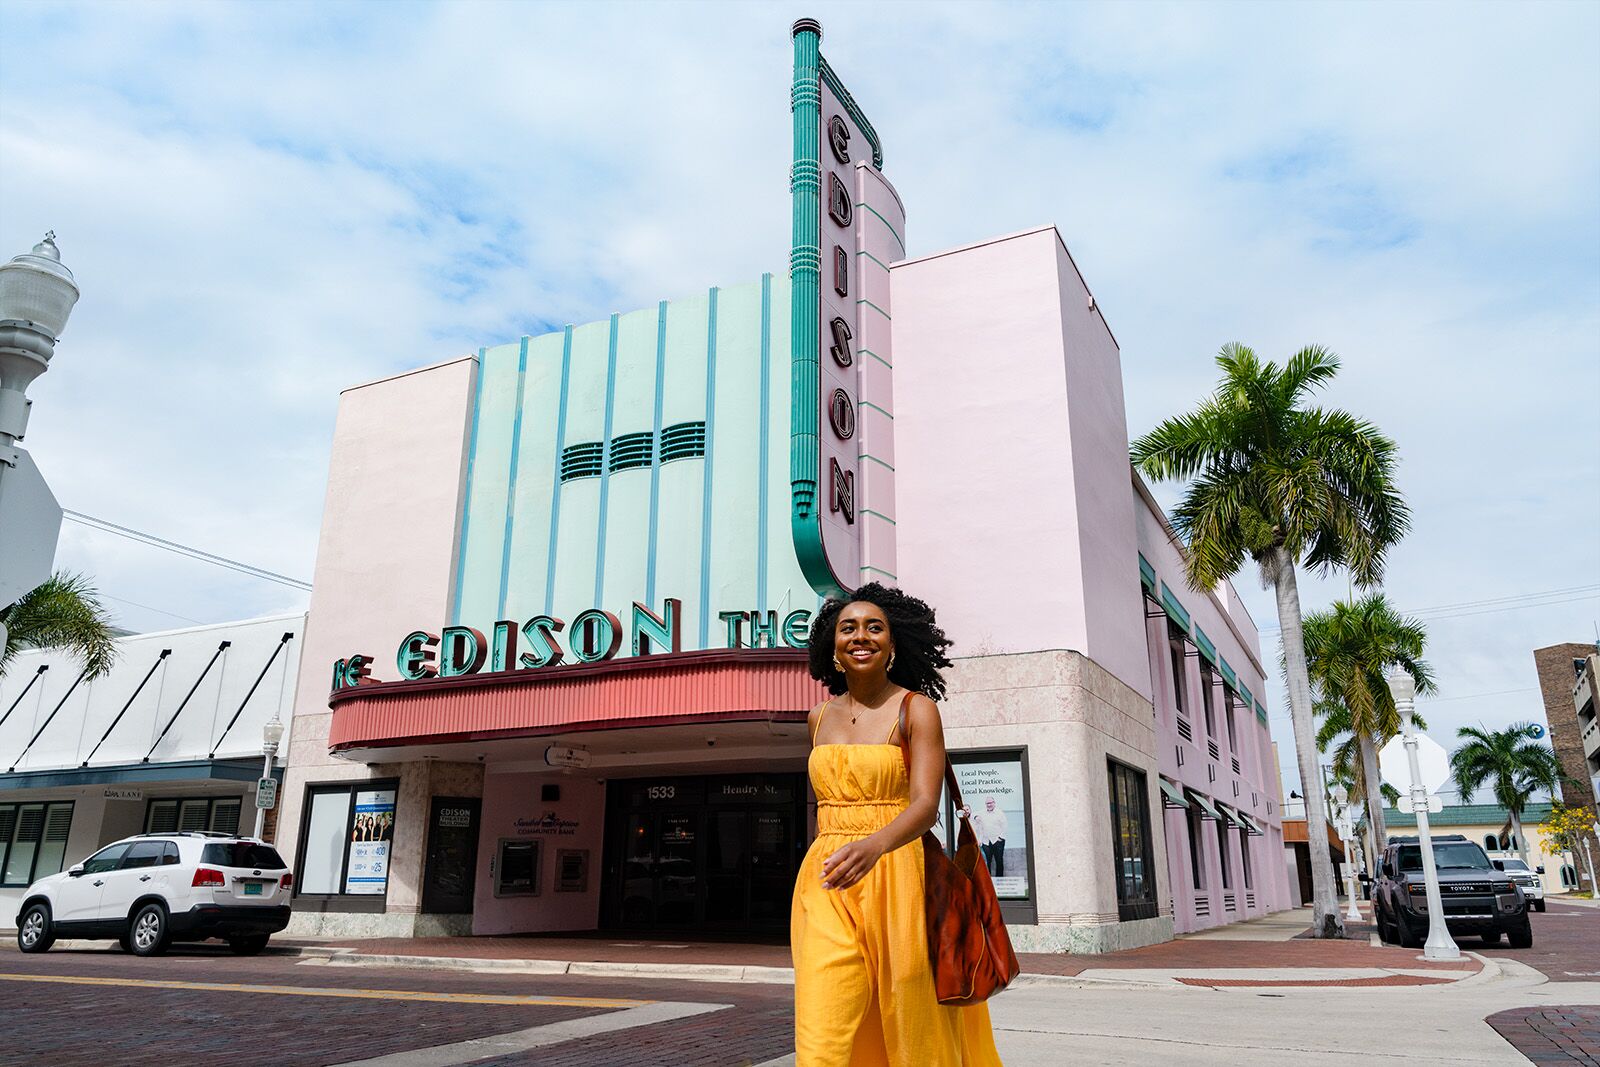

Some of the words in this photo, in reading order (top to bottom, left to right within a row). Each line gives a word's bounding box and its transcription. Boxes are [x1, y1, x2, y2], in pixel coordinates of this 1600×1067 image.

[828, 114, 855, 525] EDISON
[396, 597, 681, 681] EDISON
[647, 786, 675, 799] 1533
[722, 784, 758, 796] Hendry
[764, 784, 777, 794] St.
[440, 807, 470, 816] EDISON
